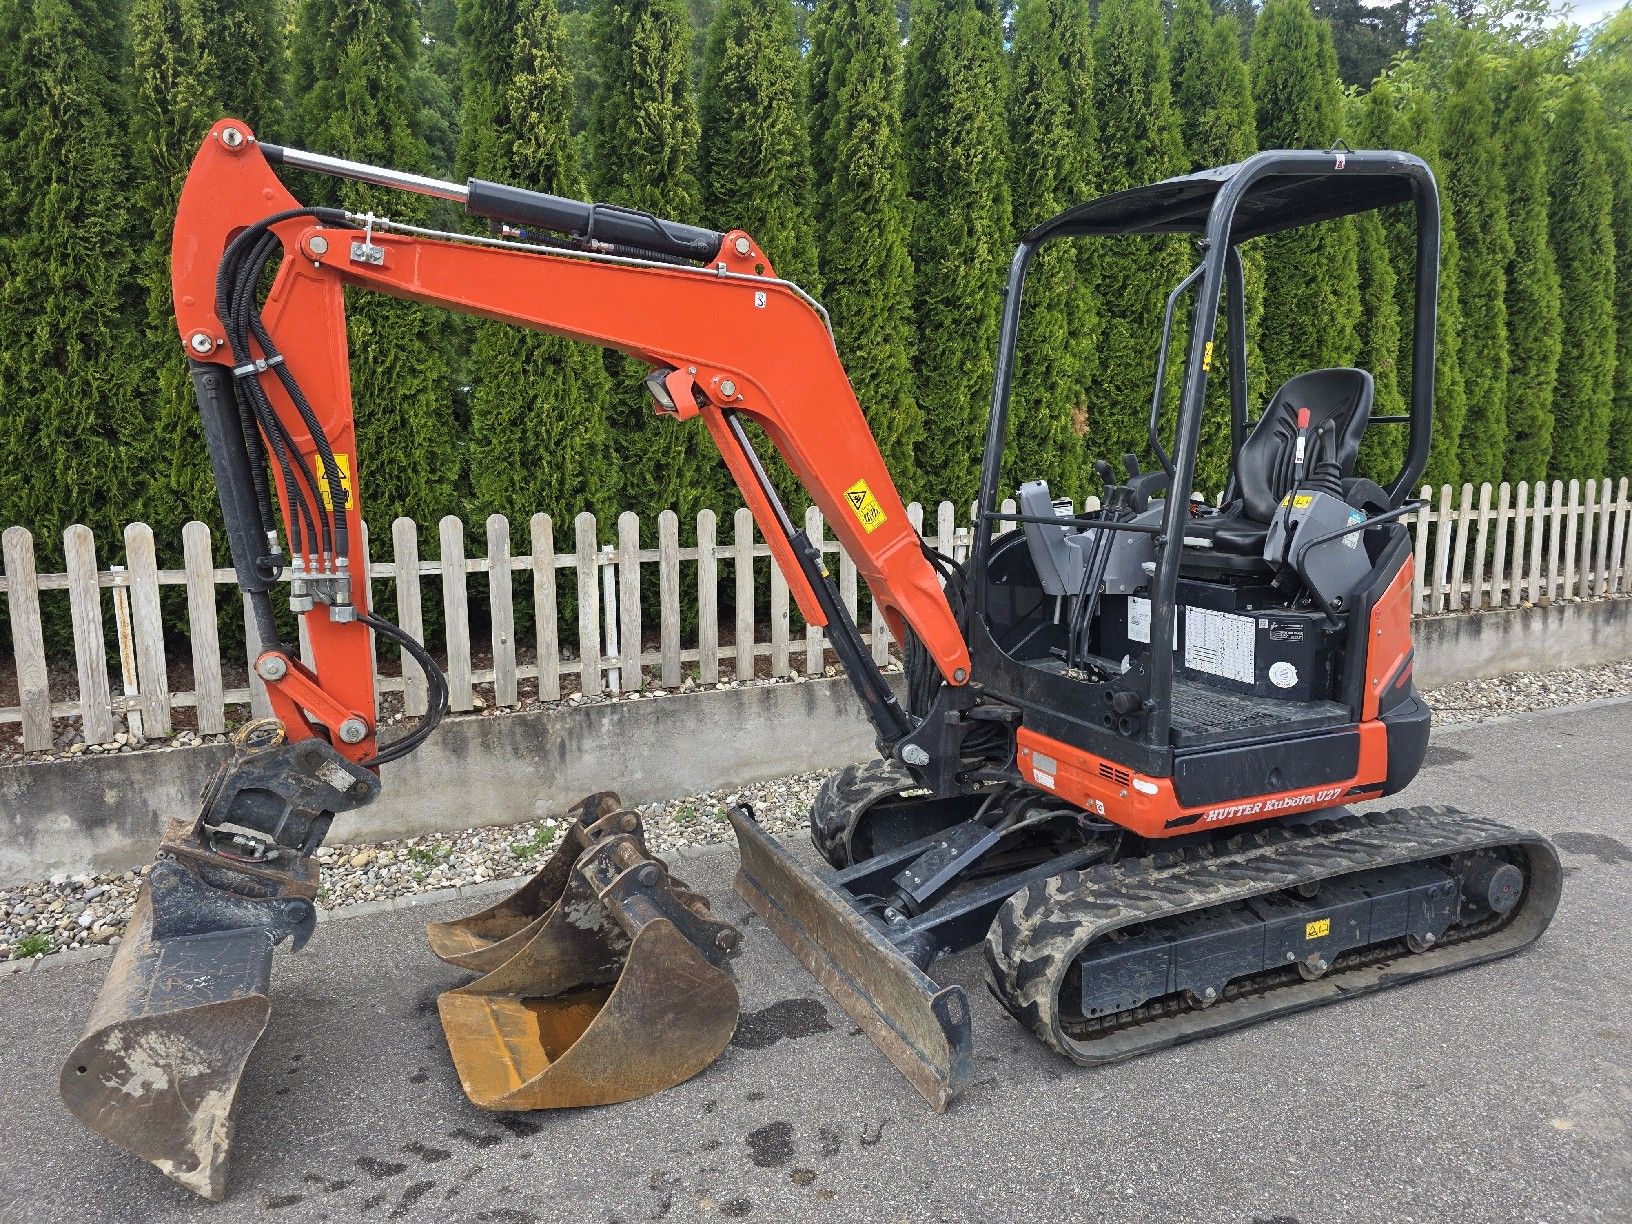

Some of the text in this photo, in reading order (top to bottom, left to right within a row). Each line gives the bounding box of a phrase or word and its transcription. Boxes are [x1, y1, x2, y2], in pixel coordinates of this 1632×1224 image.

[1206, 788, 1341, 822] HUTTER Kubota U27
